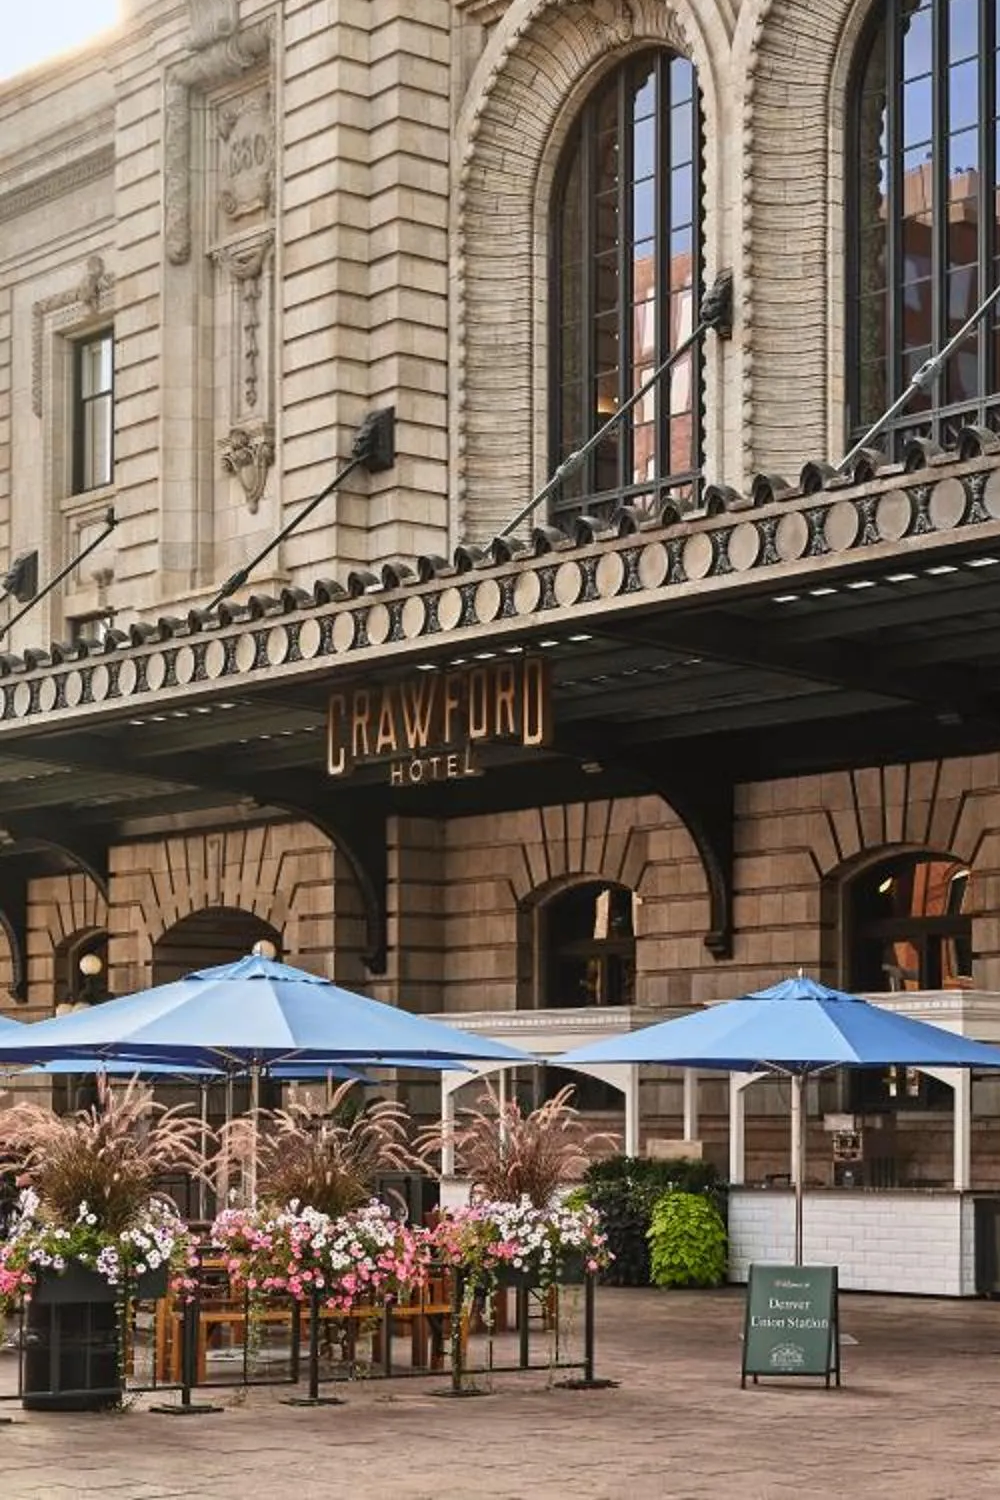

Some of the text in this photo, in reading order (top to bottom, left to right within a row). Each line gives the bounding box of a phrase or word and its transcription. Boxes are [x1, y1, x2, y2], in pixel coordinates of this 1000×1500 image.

[327, 658, 544, 776] CRAWFORD
[390, 740, 476, 787] HOTEL
[768, 1297, 811, 1312] Denver
[751, 1315, 829, 1330] Union Station
